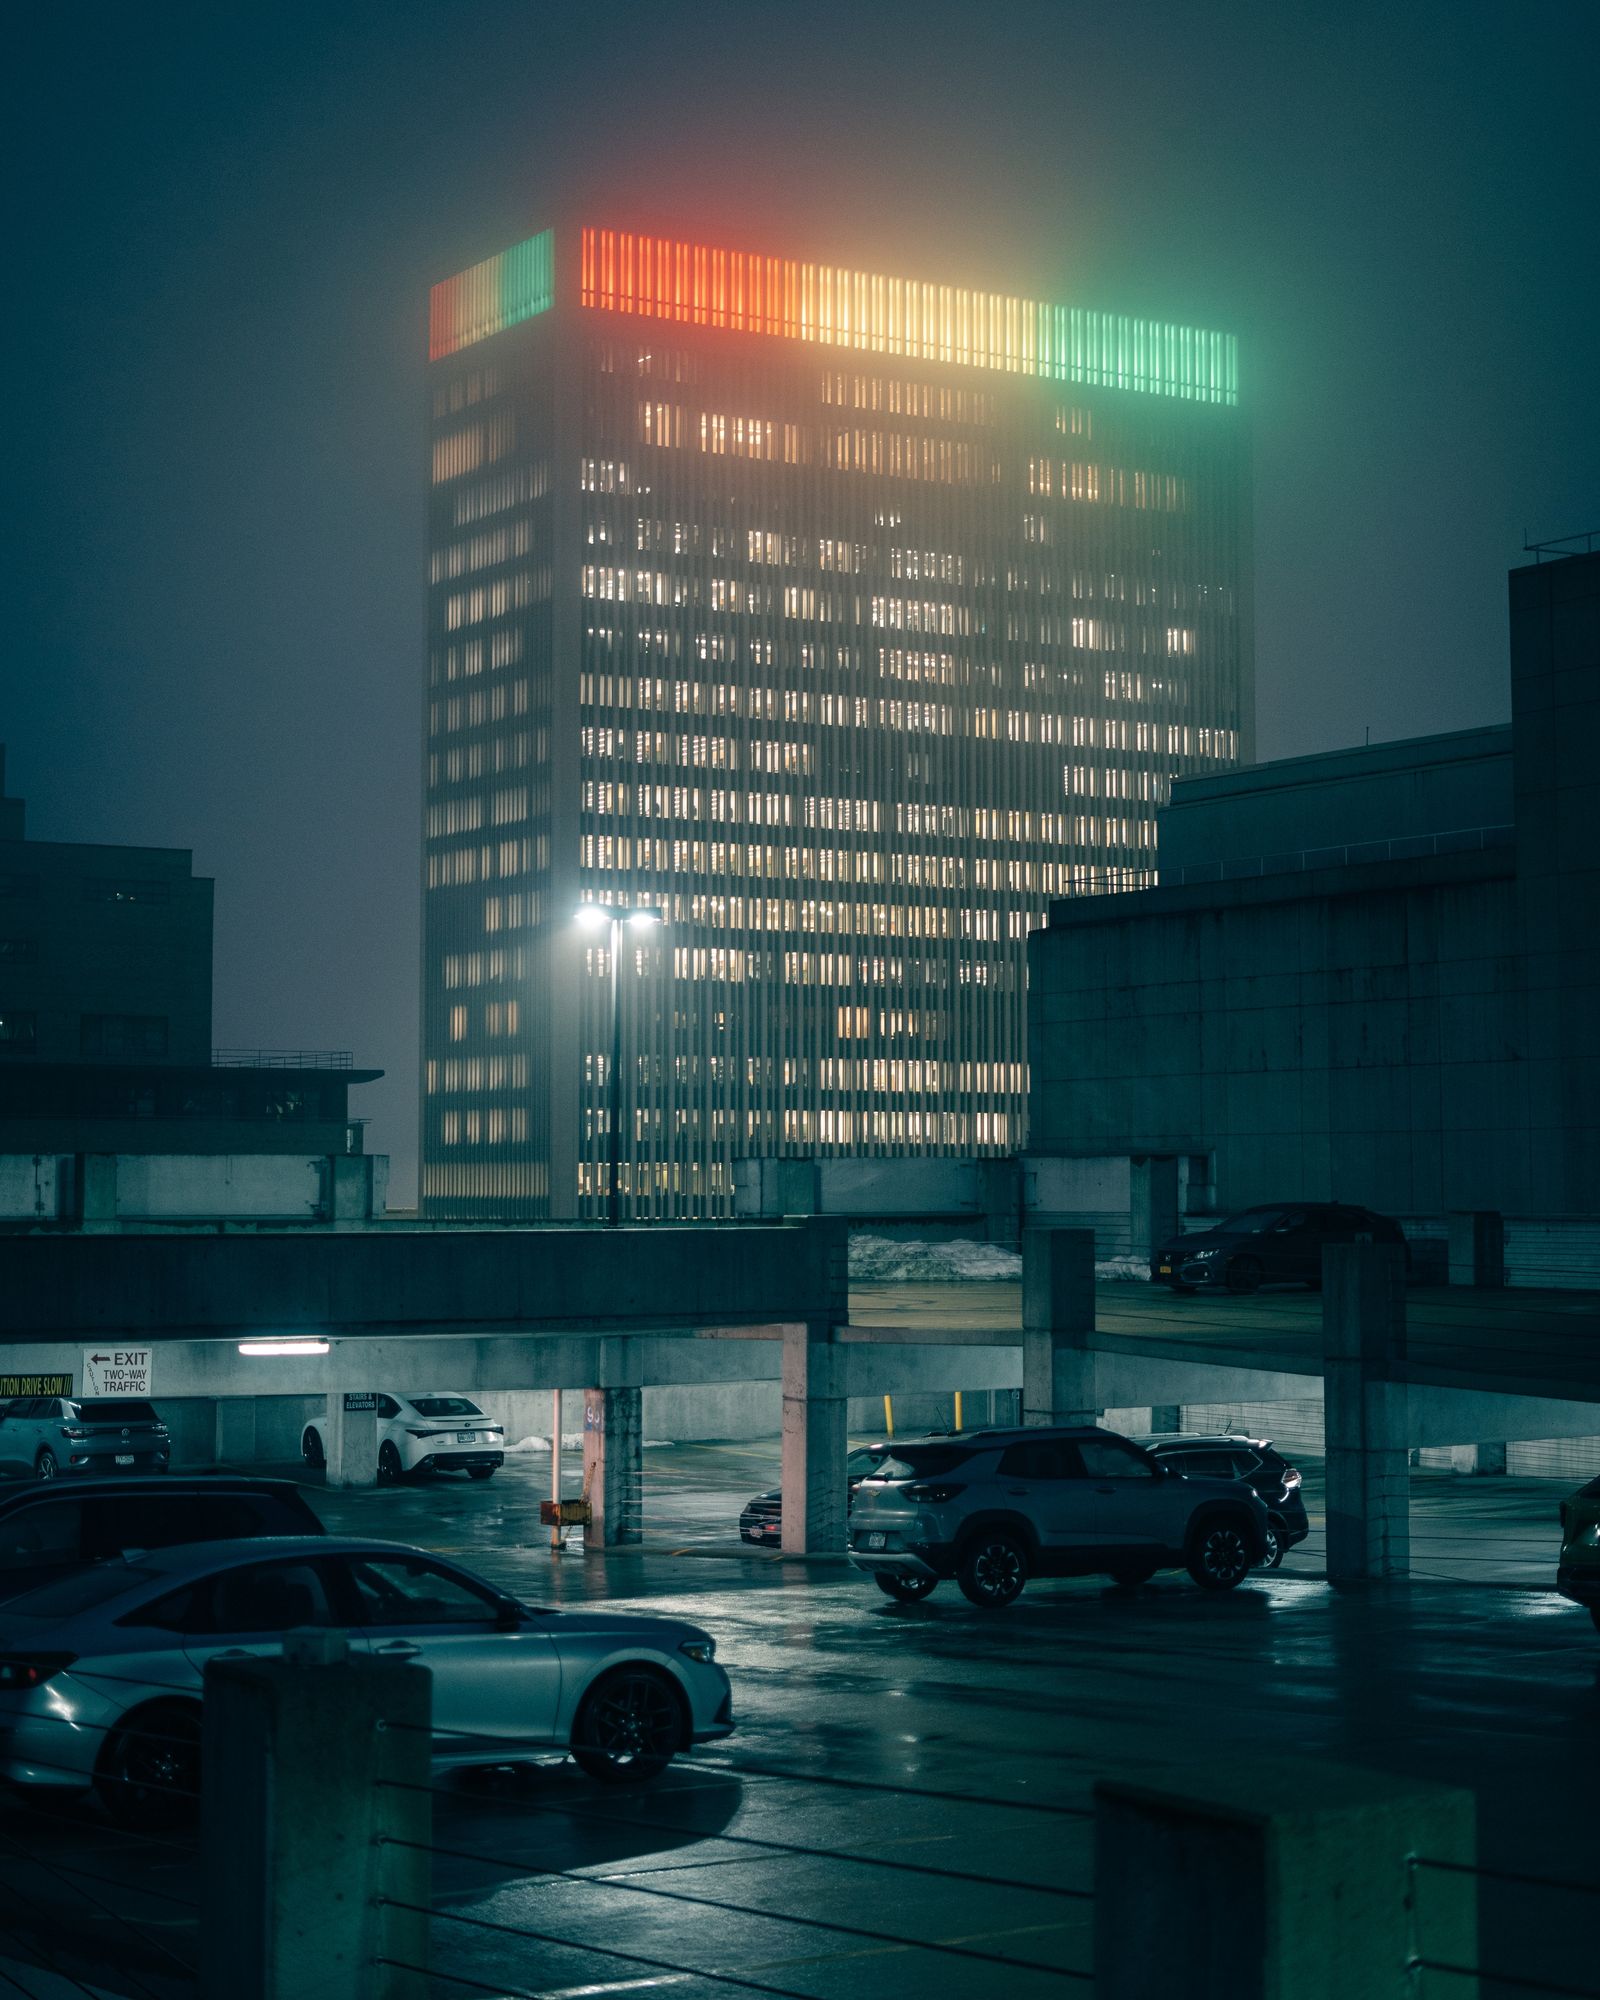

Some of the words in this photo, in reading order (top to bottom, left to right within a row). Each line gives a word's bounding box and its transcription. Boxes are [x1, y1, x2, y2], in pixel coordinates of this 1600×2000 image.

[114, 1352, 148, 1366] EXIT
[86, 1363, 100, 1396] CAUTION
[103, 1369, 147, 1380] TWO-WAY
[21, 1376, 42, 1396] DRIVE
[43, 1376, 63, 1395] SLOW
[103, 1381, 146, 1392] TRAFFIC
[346, 1401, 375, 1409] ELEVATORS
